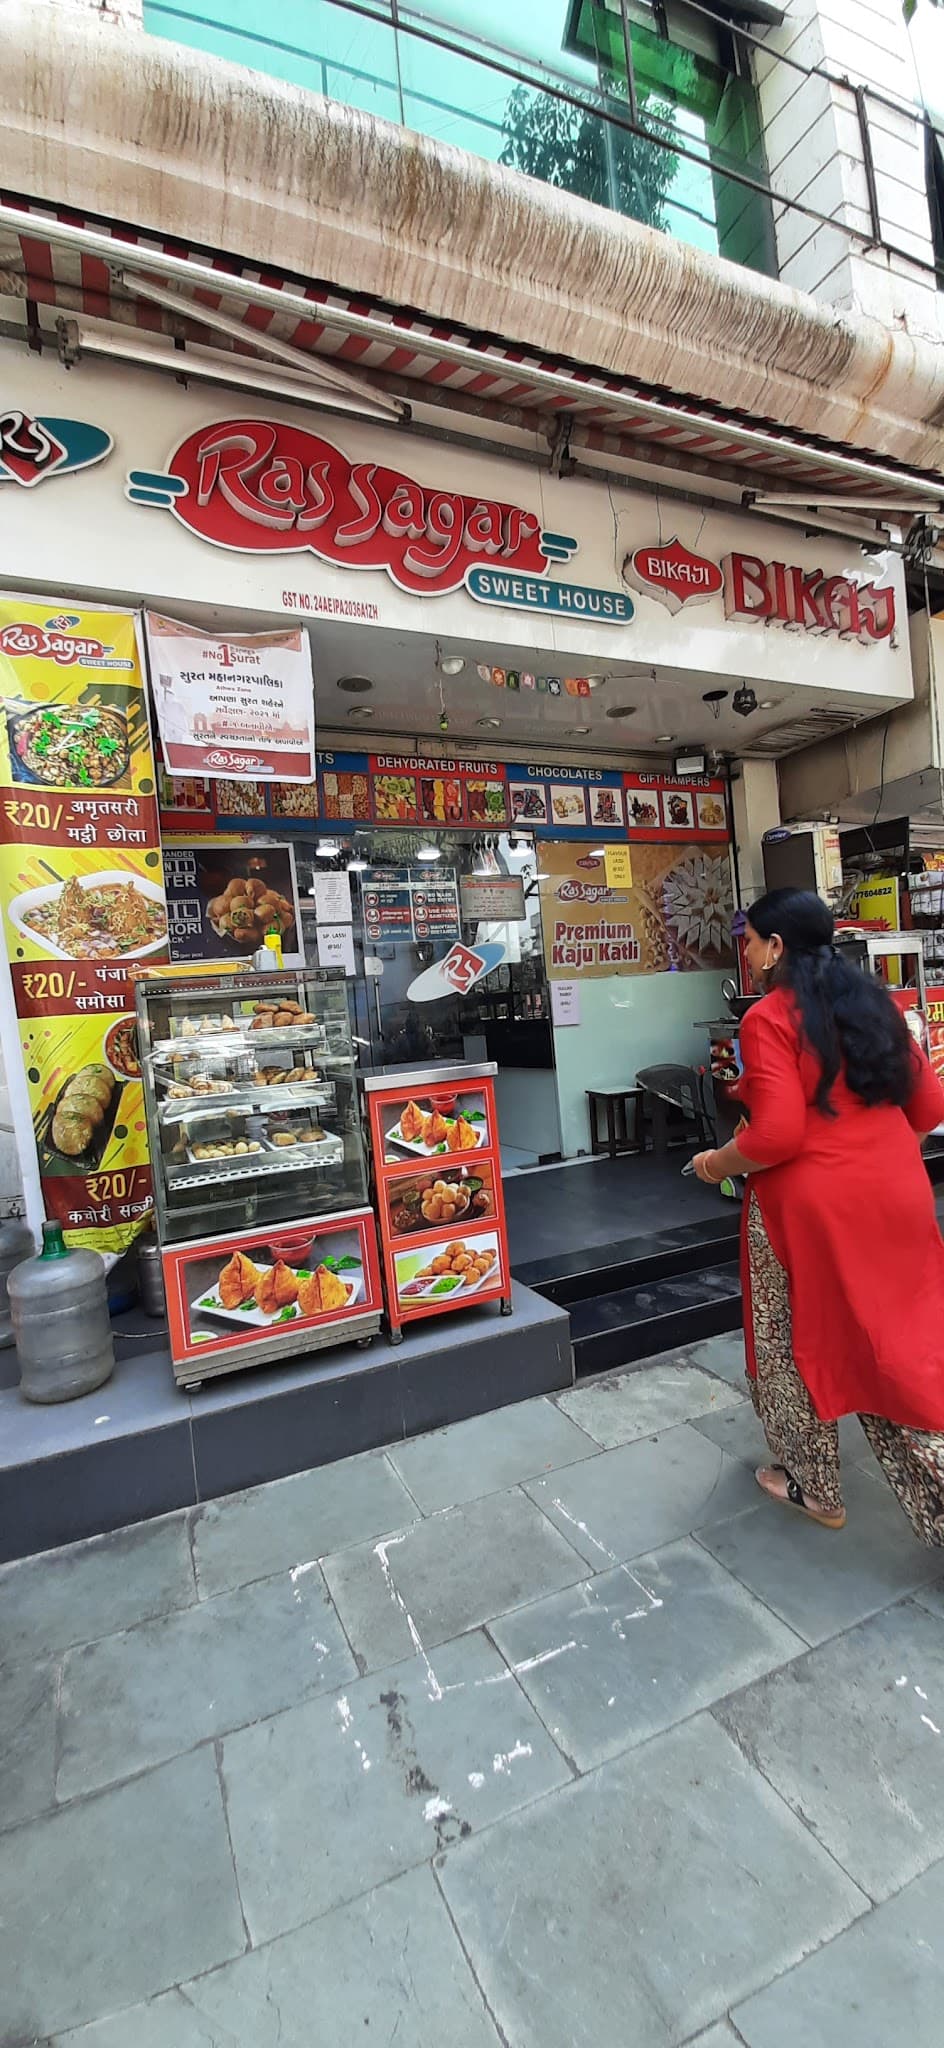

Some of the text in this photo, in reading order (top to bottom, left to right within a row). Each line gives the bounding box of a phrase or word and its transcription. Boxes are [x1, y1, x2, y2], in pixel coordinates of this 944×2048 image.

[197, 422, 539, 578] Ras Sagar
[647, 557, 710, 586] BIKAJI
[282, 590, 297, 609] GST
[299, 593, 313, 610] NO.
[478, 573, 626, 617] SWEET HOUSE
[3, 627, 99, 661] Ras Sagar
[180, 671, 283, 688] સુરત મહાનગરપાલિકા
[209, 695, 236, 703] આપણા
[240, 697, 258, 706] સુરત
[211, 752, 228, 765] Ras
[229, 754, 256, 769] Sagar
[316, 752, 334, 765] TS
[377, 756, 498, 774] DEHYDRATED FRUITS
[527, 766, 602, 781] CHOCOLATES
[638, 774, 710, 787] GIFT HAMPERS
[4, 799, 139, 831] ₹20/- अमृतसरी
[105, 824, 147, 842] छोला
[162, 850, 194, 858] ANDED
[164, 874, 197, 888] TER
[561, 882, 579, 898] Ras
[579, 884, 609, 901] Sagar
[168, 923, 202, 935] HORI
[555, 920, 632, 941] Premium
[552, 941, 638, 967] Kaju Katli
[22, 970, 87, 999] ₹20/-
[73, 990, 126, 1010] समोसा
[86, 1169, 147, 1201] ₹20/-
[67, 1204, 112, 1224] कचोरी
